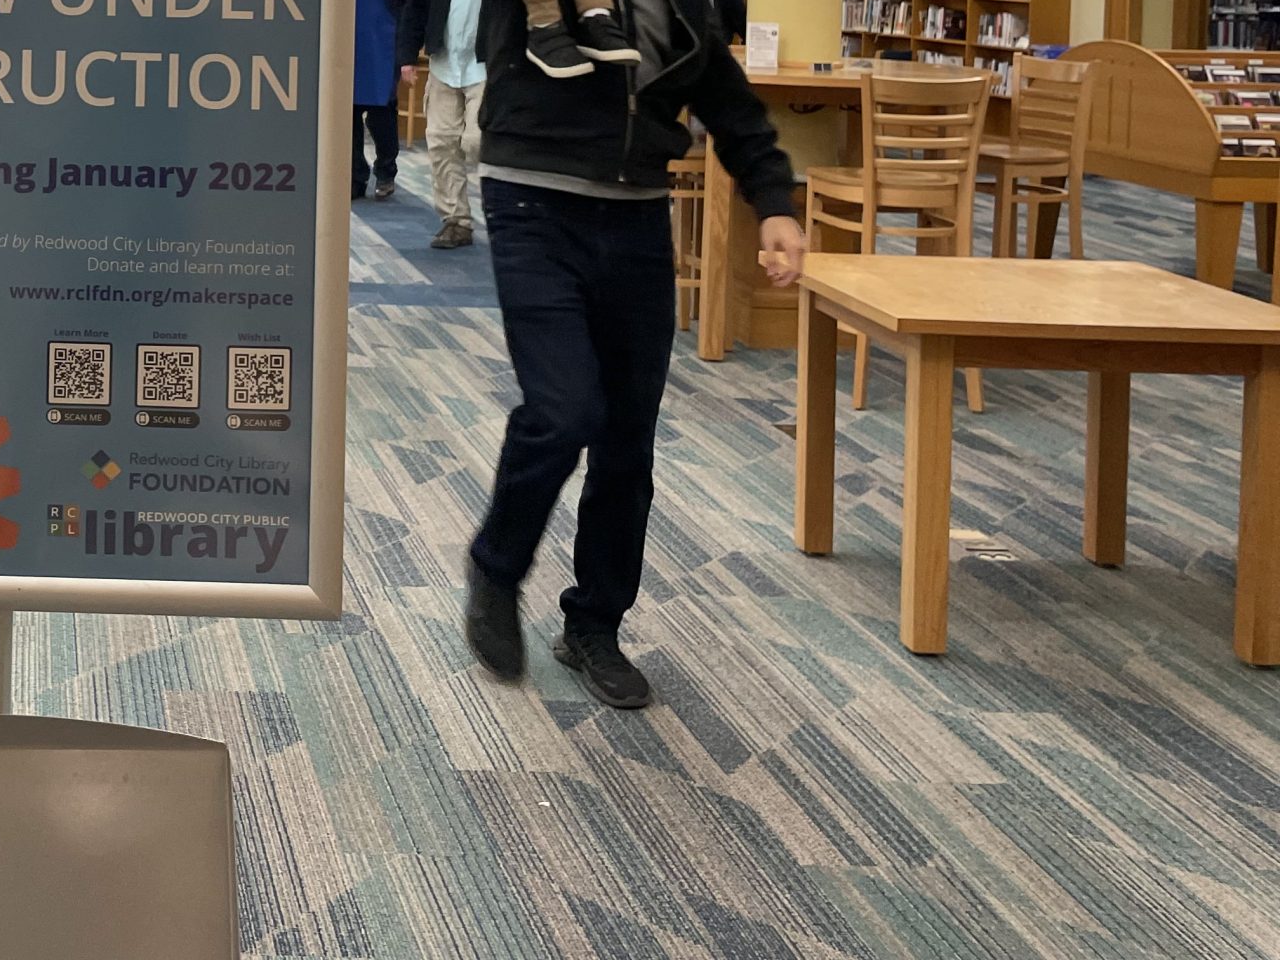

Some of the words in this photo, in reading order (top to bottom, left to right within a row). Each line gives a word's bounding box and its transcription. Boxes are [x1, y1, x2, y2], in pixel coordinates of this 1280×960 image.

[42, 157, 198, 198] January
[208, 161, 297, 193] 2022
[12, 235, 31, 252] by
[34, 235, 108, 251] Redwood
[113, 237, 142, 255] City
[146, 238, 201, 257] Library
[205, 239, 295, 256] Foundation
[87, 257, 145, 274] Donate
[149, 258, 179, 275] and
[183, 259, 223, 275] learn
[228, 264, 270, 276] more
[275, 262, 295, 277] at:
[9, 284, 294, 309] www.rclfdn.org/makerspace
[54, 328, 81, 338] Learn
[83, 329, 109, 338] More
[152, 330, 188, 340] Donate
[237, 332, 261, 342] Wish
[263, 333, 281, 342] List
[64, 413, 89, 422] SCAN
[91, 413, 103, 422] ME
[152, 415, 177, 425] SCAN
[179, 416, 191, 425] ME
[243, 419, 268, 428] SCAN
[270, 419, 282, 428] ME
[129, 452, 200, 467] Redwood
[204, 454, 234, 471] City
[238, 455, 290, 472] Library
[128, 472, 291, 496] FOUNDATION
[137, 511, 208, 524] REDWOOD
[211, 513, 240, 525] CITY
[243, 514, 289, 526] PUBLIC
[84, 509, 289, 574] library
